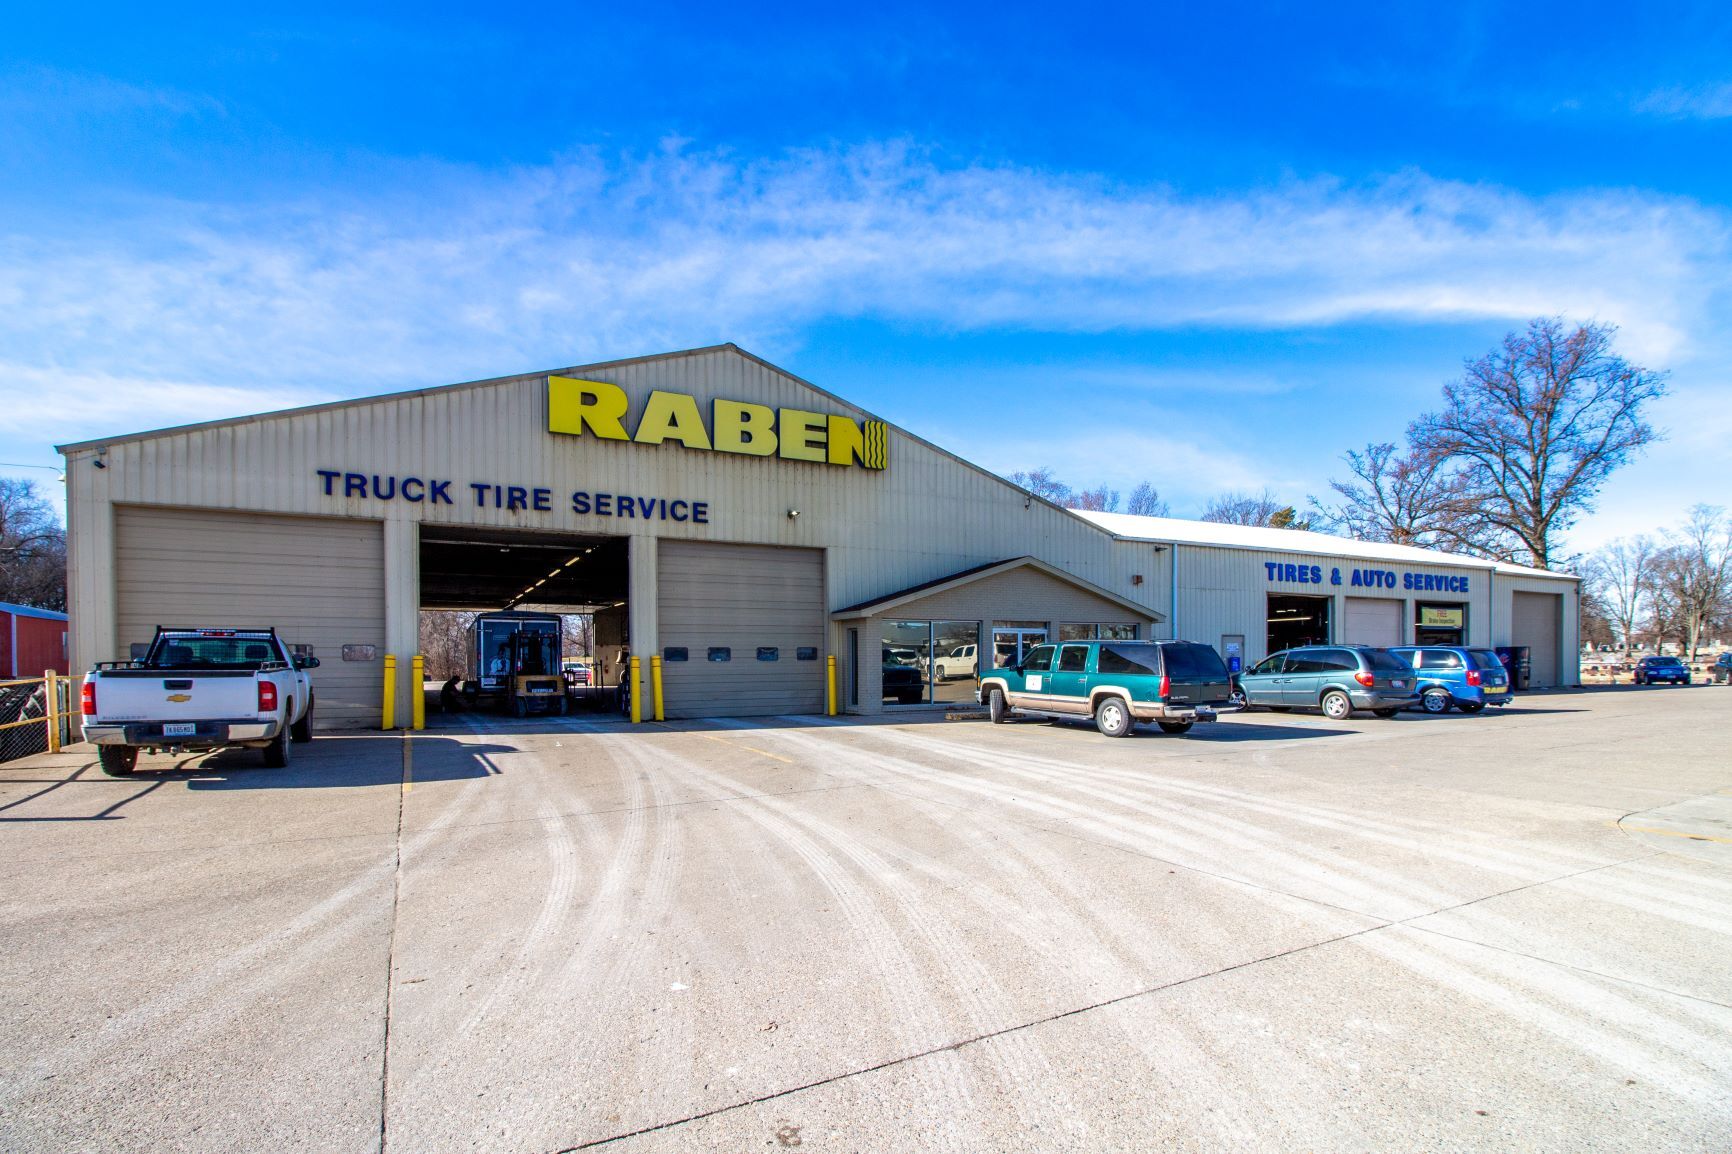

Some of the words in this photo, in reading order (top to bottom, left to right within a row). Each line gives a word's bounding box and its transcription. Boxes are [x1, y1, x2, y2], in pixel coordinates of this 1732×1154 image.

[548, 375, 888, 471] RABEN
[317, 470, 454, 505] TRUCK
[470, 483, 552, 511] TIRE
[572, 491, 709, 524] SERVICE
[1265, 562, 1322, 584] TIRES
[1330, 567, 1342, 586] &
[1351, 569, 1397, 589] AUTO
[1403, 572, 1470, 593] SERVICE
